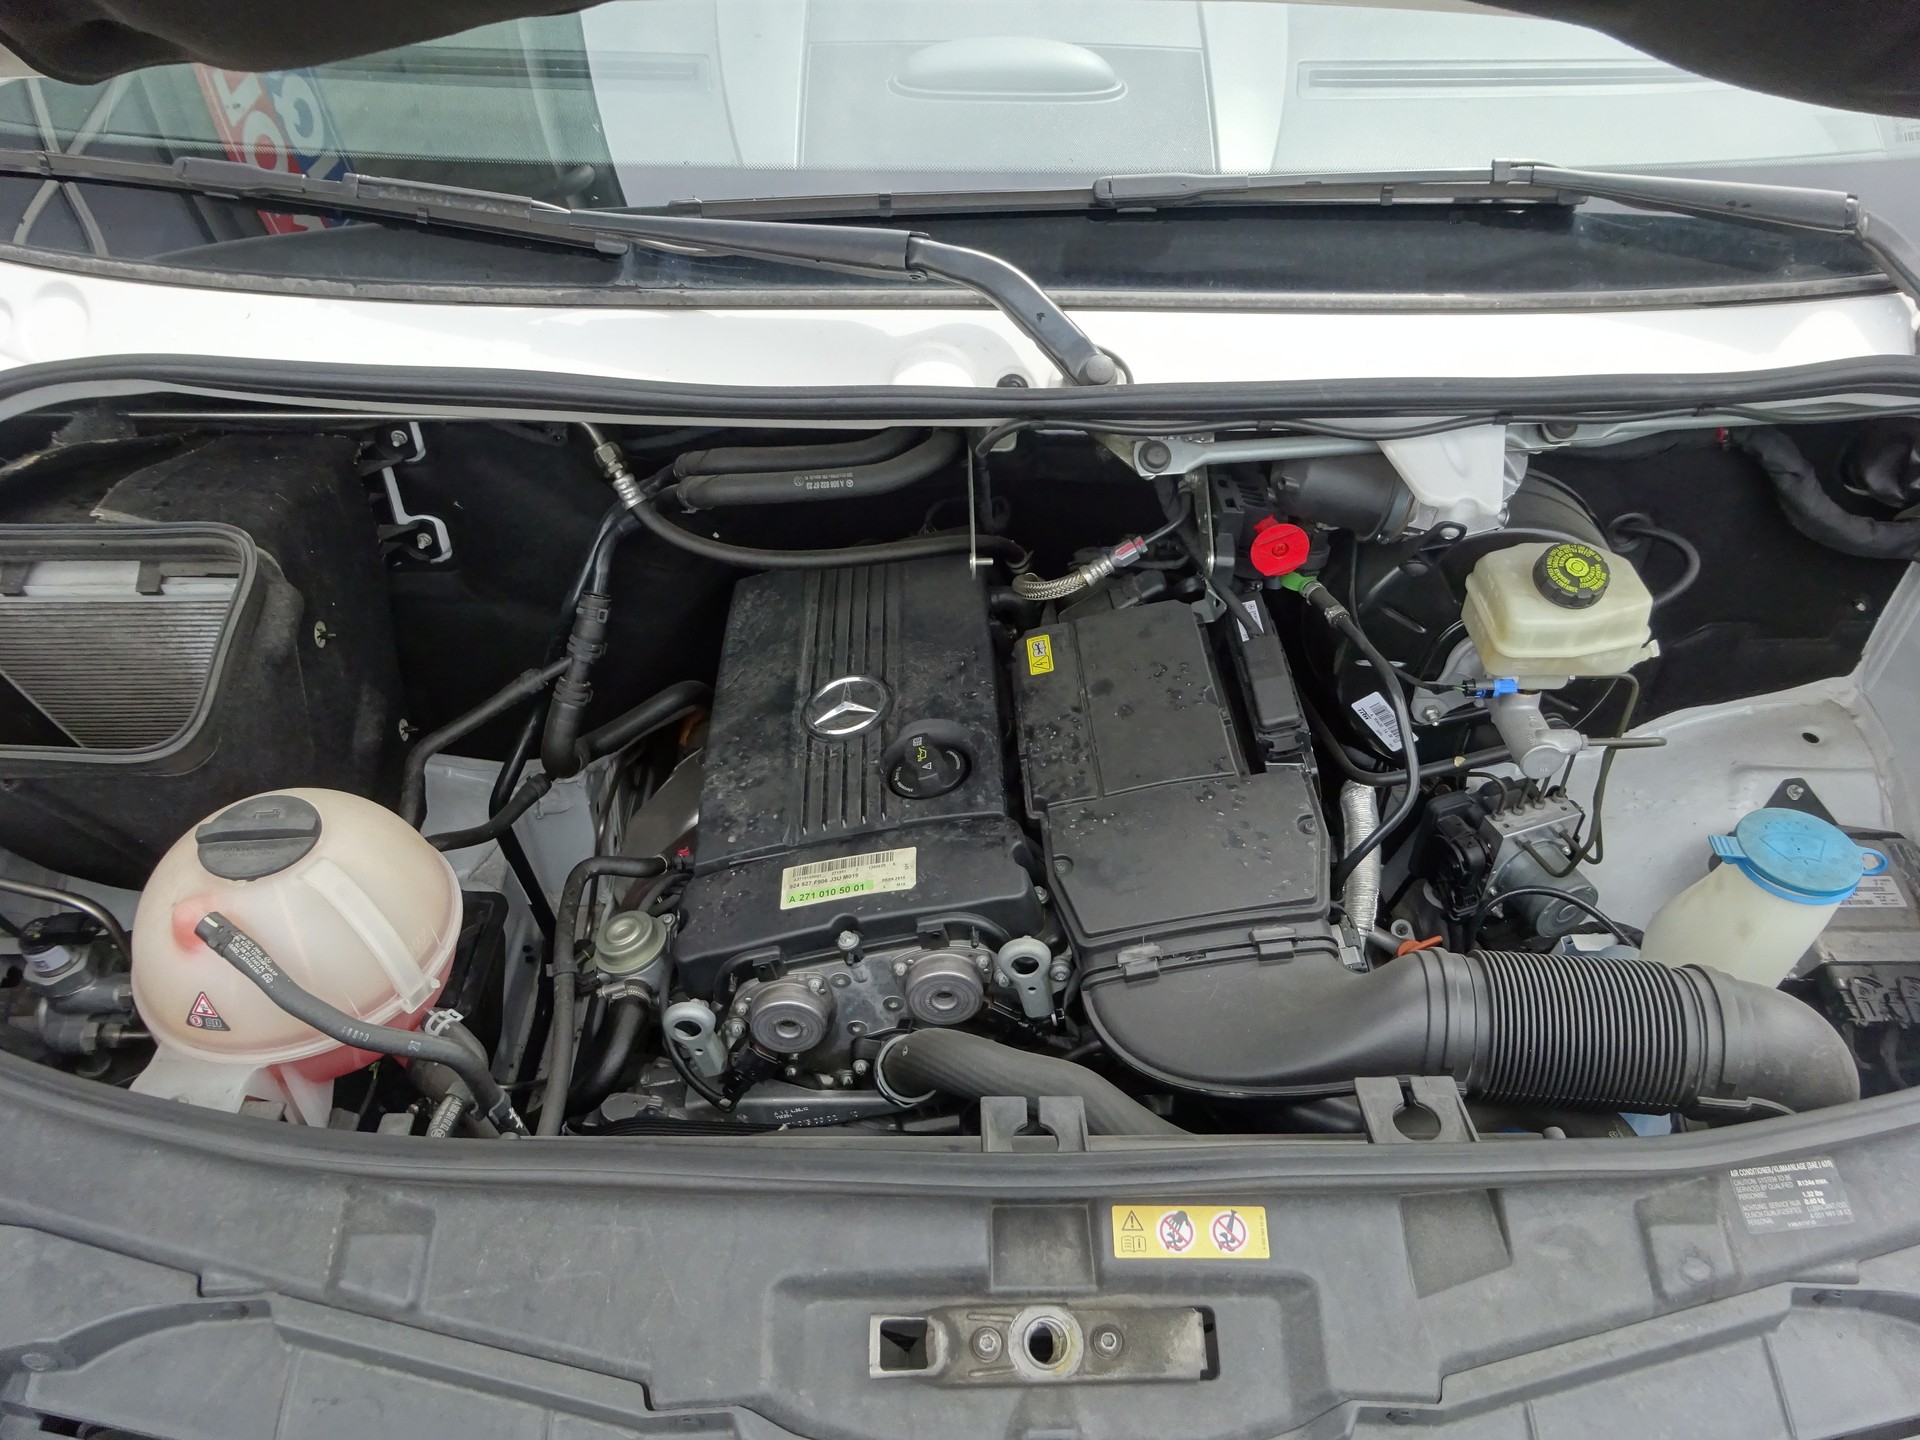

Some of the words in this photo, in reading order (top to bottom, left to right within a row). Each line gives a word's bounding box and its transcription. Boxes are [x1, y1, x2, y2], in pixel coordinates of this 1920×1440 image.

[789, 895, 796, 904] A
[799, 892, 816, 902] 271
[820, 888, 836, 898] 010
[839, 885, 851, 895] 50
[853, 883, 865, 892] 01
[1730, 1168, 1740, 1177] AIR
